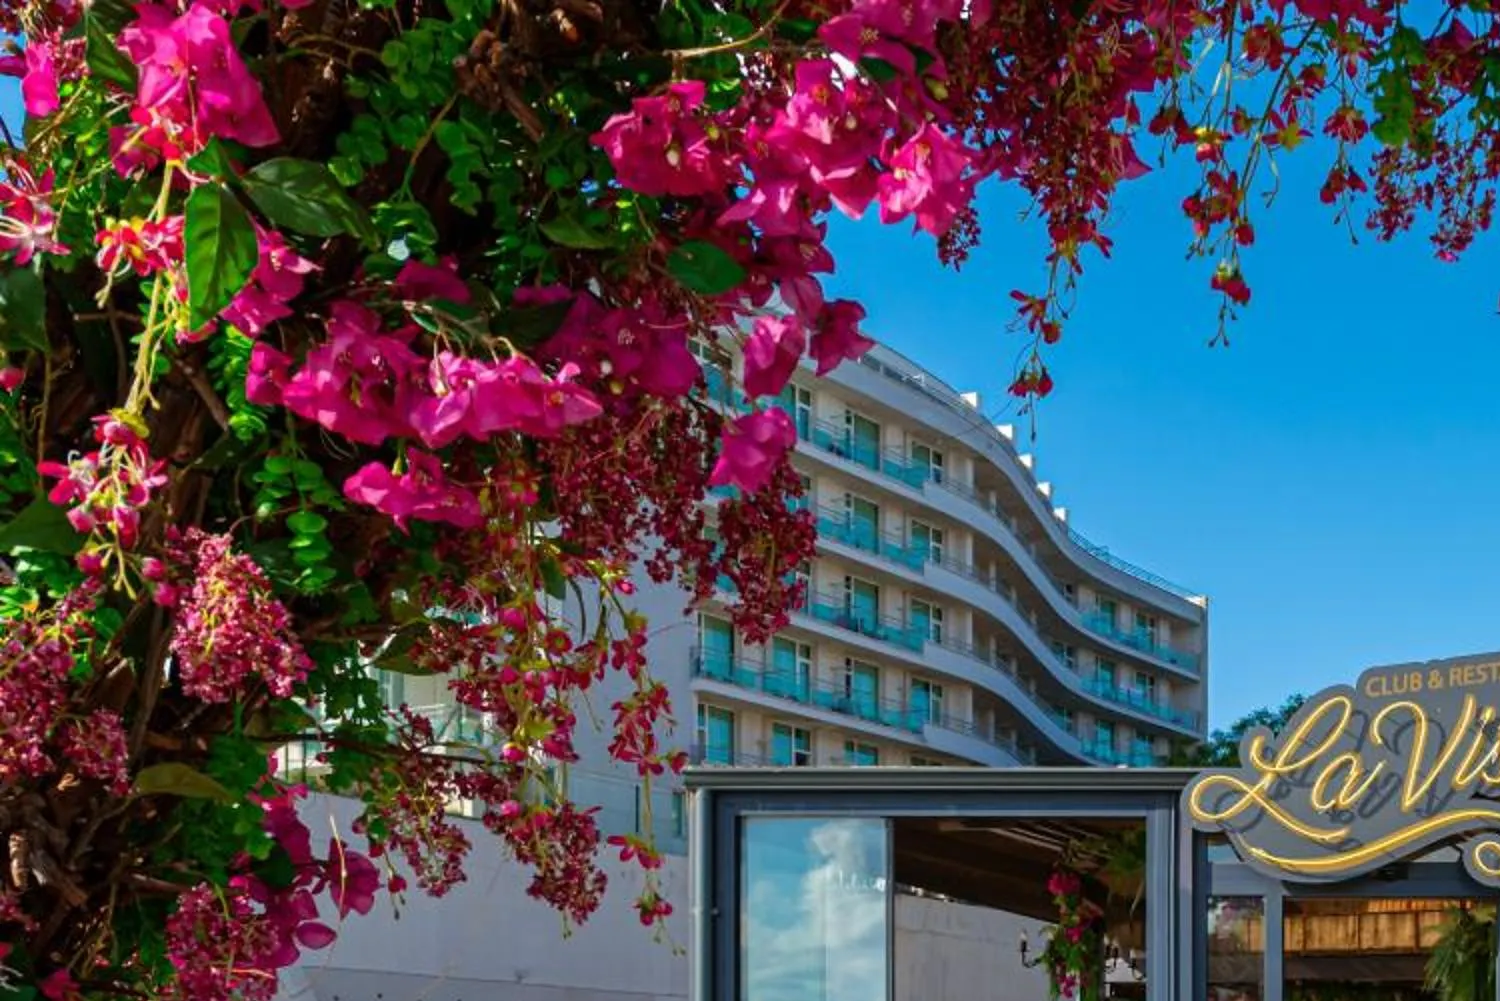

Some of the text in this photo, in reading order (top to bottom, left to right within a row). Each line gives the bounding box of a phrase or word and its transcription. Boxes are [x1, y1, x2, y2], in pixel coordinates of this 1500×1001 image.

[1364, 671, 1423, 698] CLUB
[1428, 669, 1444, 690] &
[1189, 695, 1387, 841] La
